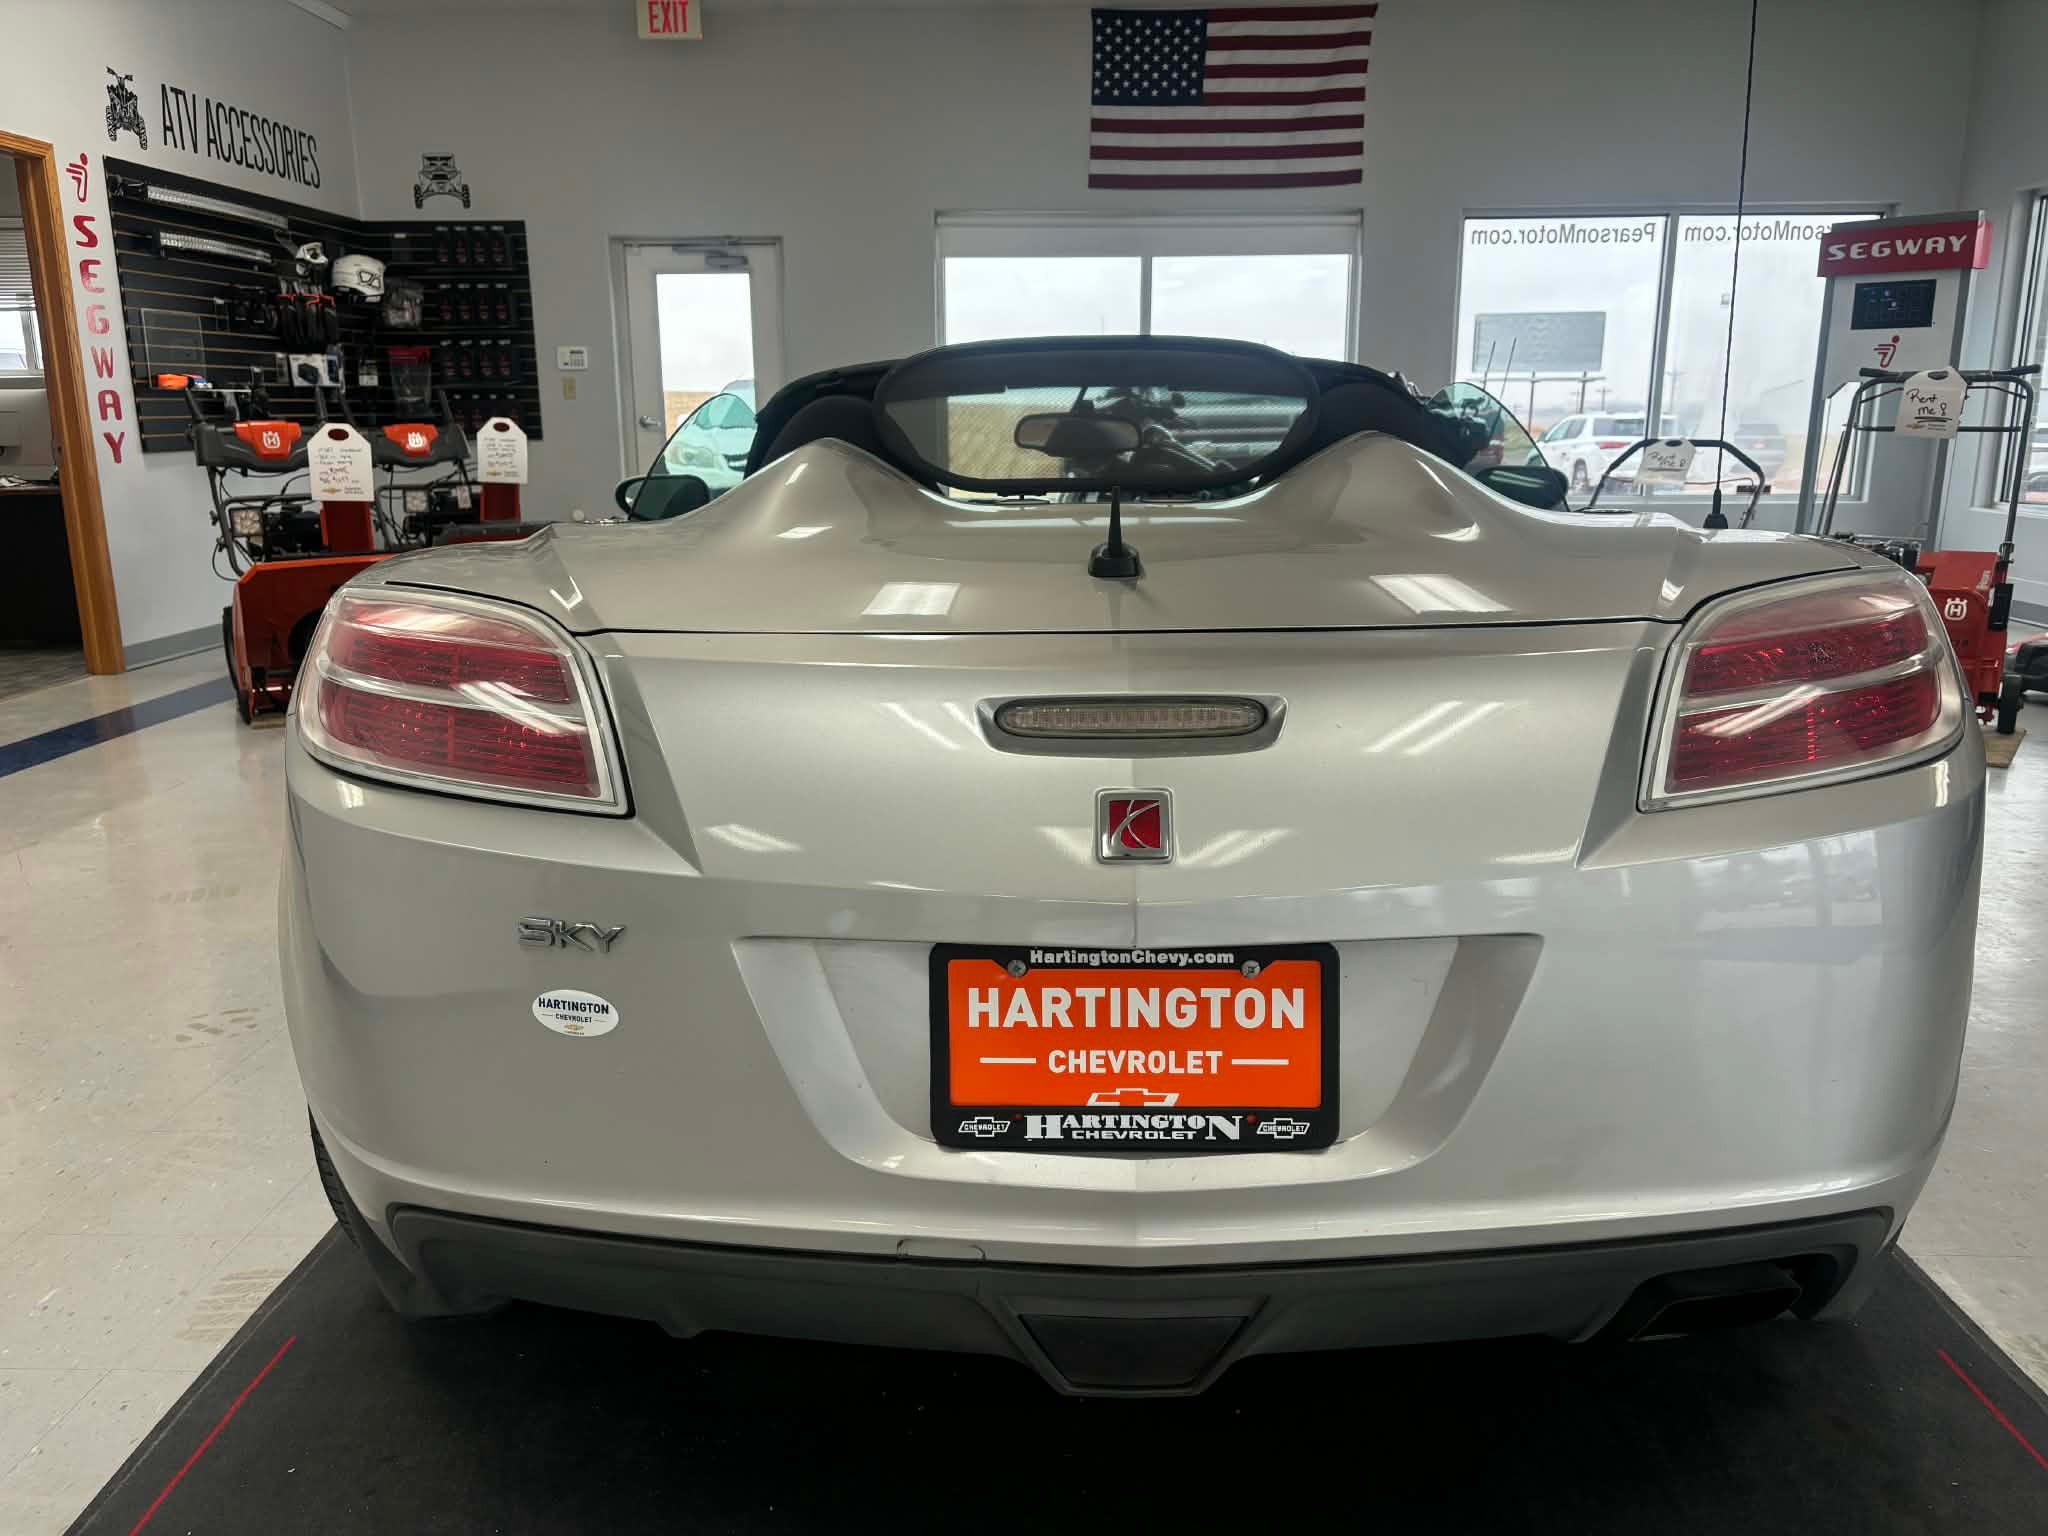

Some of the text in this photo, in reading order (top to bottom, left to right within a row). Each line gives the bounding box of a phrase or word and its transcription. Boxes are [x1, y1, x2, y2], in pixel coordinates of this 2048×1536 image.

[648, 0, 688, 33] EXIT
[161, 83, 321, 189] ATV ACCESSORIES
[1827, 234, 1967, 261] SEGWAY
[73, 215, 126, 464] SEGWAY
[1906, 388, 1937, 404] Rent
[518, 916, 625, 952] SKY
[1030, 949, 1235, 967] HartingtonChevy.com
[538, 997, 610, 1015] HARTINGTON
[555, 1013, 592, 1023] CHEVROLET
[968, 987, 1304, 1029] HARTINGTON
[1048, 1049, 1223, 1075] CHEVROLET
[963, 1122, 1006, 1132] CHEVROLET
[1024, 1114, 1243, 1141] HARTINGTON
[1071, 1130, 1197, 1140] CHEVROLET
[1262, 1124, 1305, 1133] CHEVROLET
